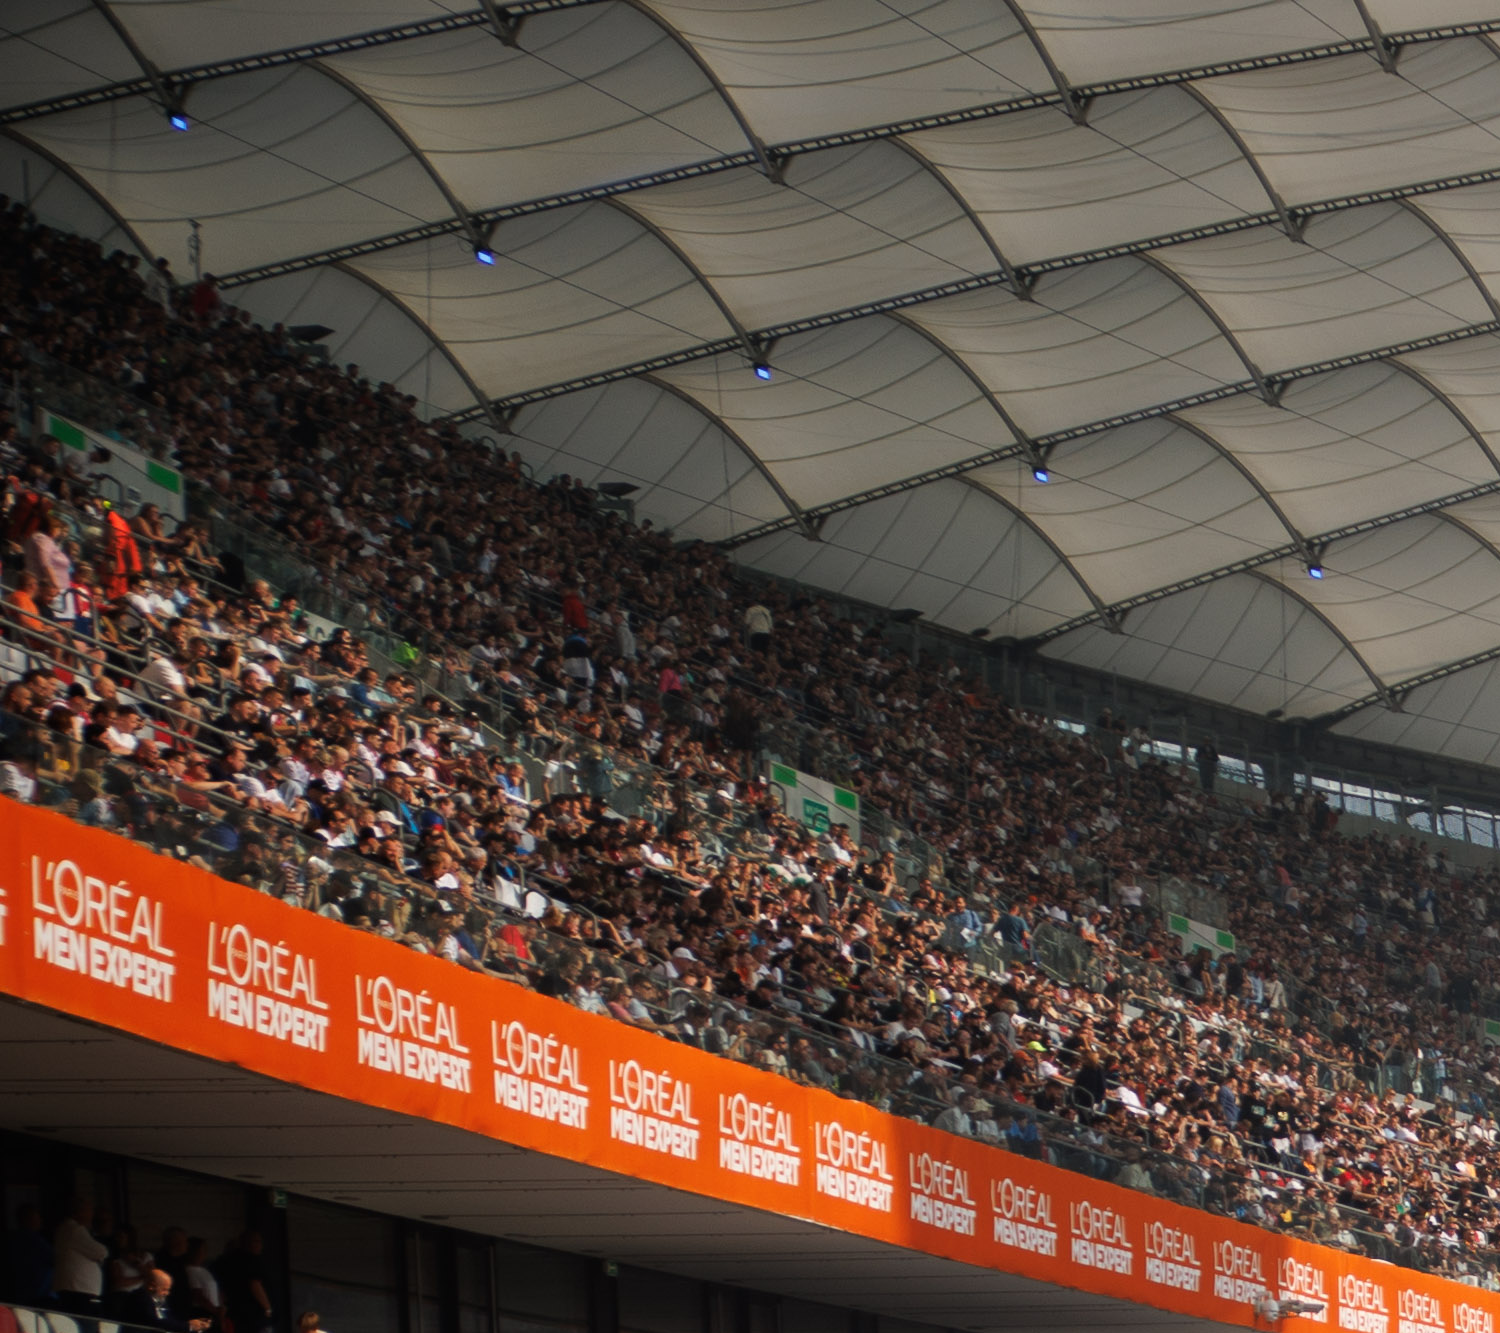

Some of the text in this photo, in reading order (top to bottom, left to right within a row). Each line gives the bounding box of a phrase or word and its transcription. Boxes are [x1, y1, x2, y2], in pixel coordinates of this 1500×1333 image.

[33, 856, 174, 956] L'ORÉAL
[34, 918, 175, 1002] MEN EXPERT
[208, 922, 328, 1009] L'ORÉAL
[208, 979, 329, 1051] MEN EXPERT
[356, 975, 469, 1053] L'ORÉAL
[358, 1028, 471, 1092] MEN EXPERT
[492, 1020, 588, 1092] L'ORÉAL
[494, 1070, 589, 1128] MEN EXPERT
[610, 1059, 699, 1125] L'ORÉAL
[720, 1092, 800, 1152] L'ORÉAL
[611, 1106, 700, 1159] MEN EXPERT
[720, 1137, 800, 1185] MEN EXPERT
[816, 1121, 893, 1180] L'ORÉAL
[817, 1163, 893, 1211] MEN EXPERT
[910, 1153, 975, 1205] L'ORÉAL
[912, 1192, 976, 1235] MEN EXPERT
